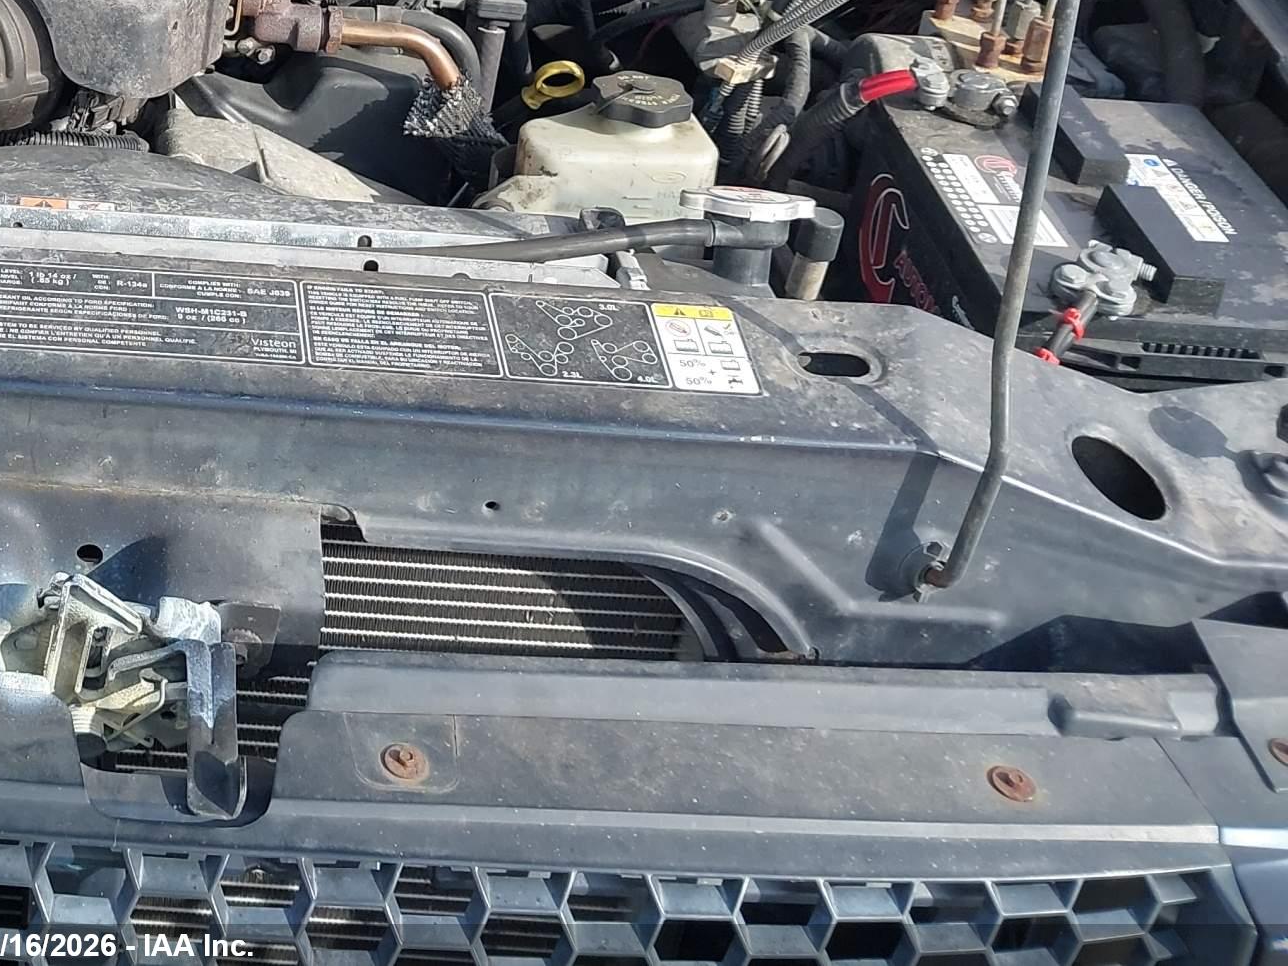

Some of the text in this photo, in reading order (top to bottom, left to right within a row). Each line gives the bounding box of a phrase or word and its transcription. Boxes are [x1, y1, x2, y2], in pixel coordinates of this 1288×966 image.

[116, 280, 148, 288] R-134a
[251, 337, 297, 348] Visteon
[680, 359, 706, 368] 50%
[686, 377, 712, 386] 50%
